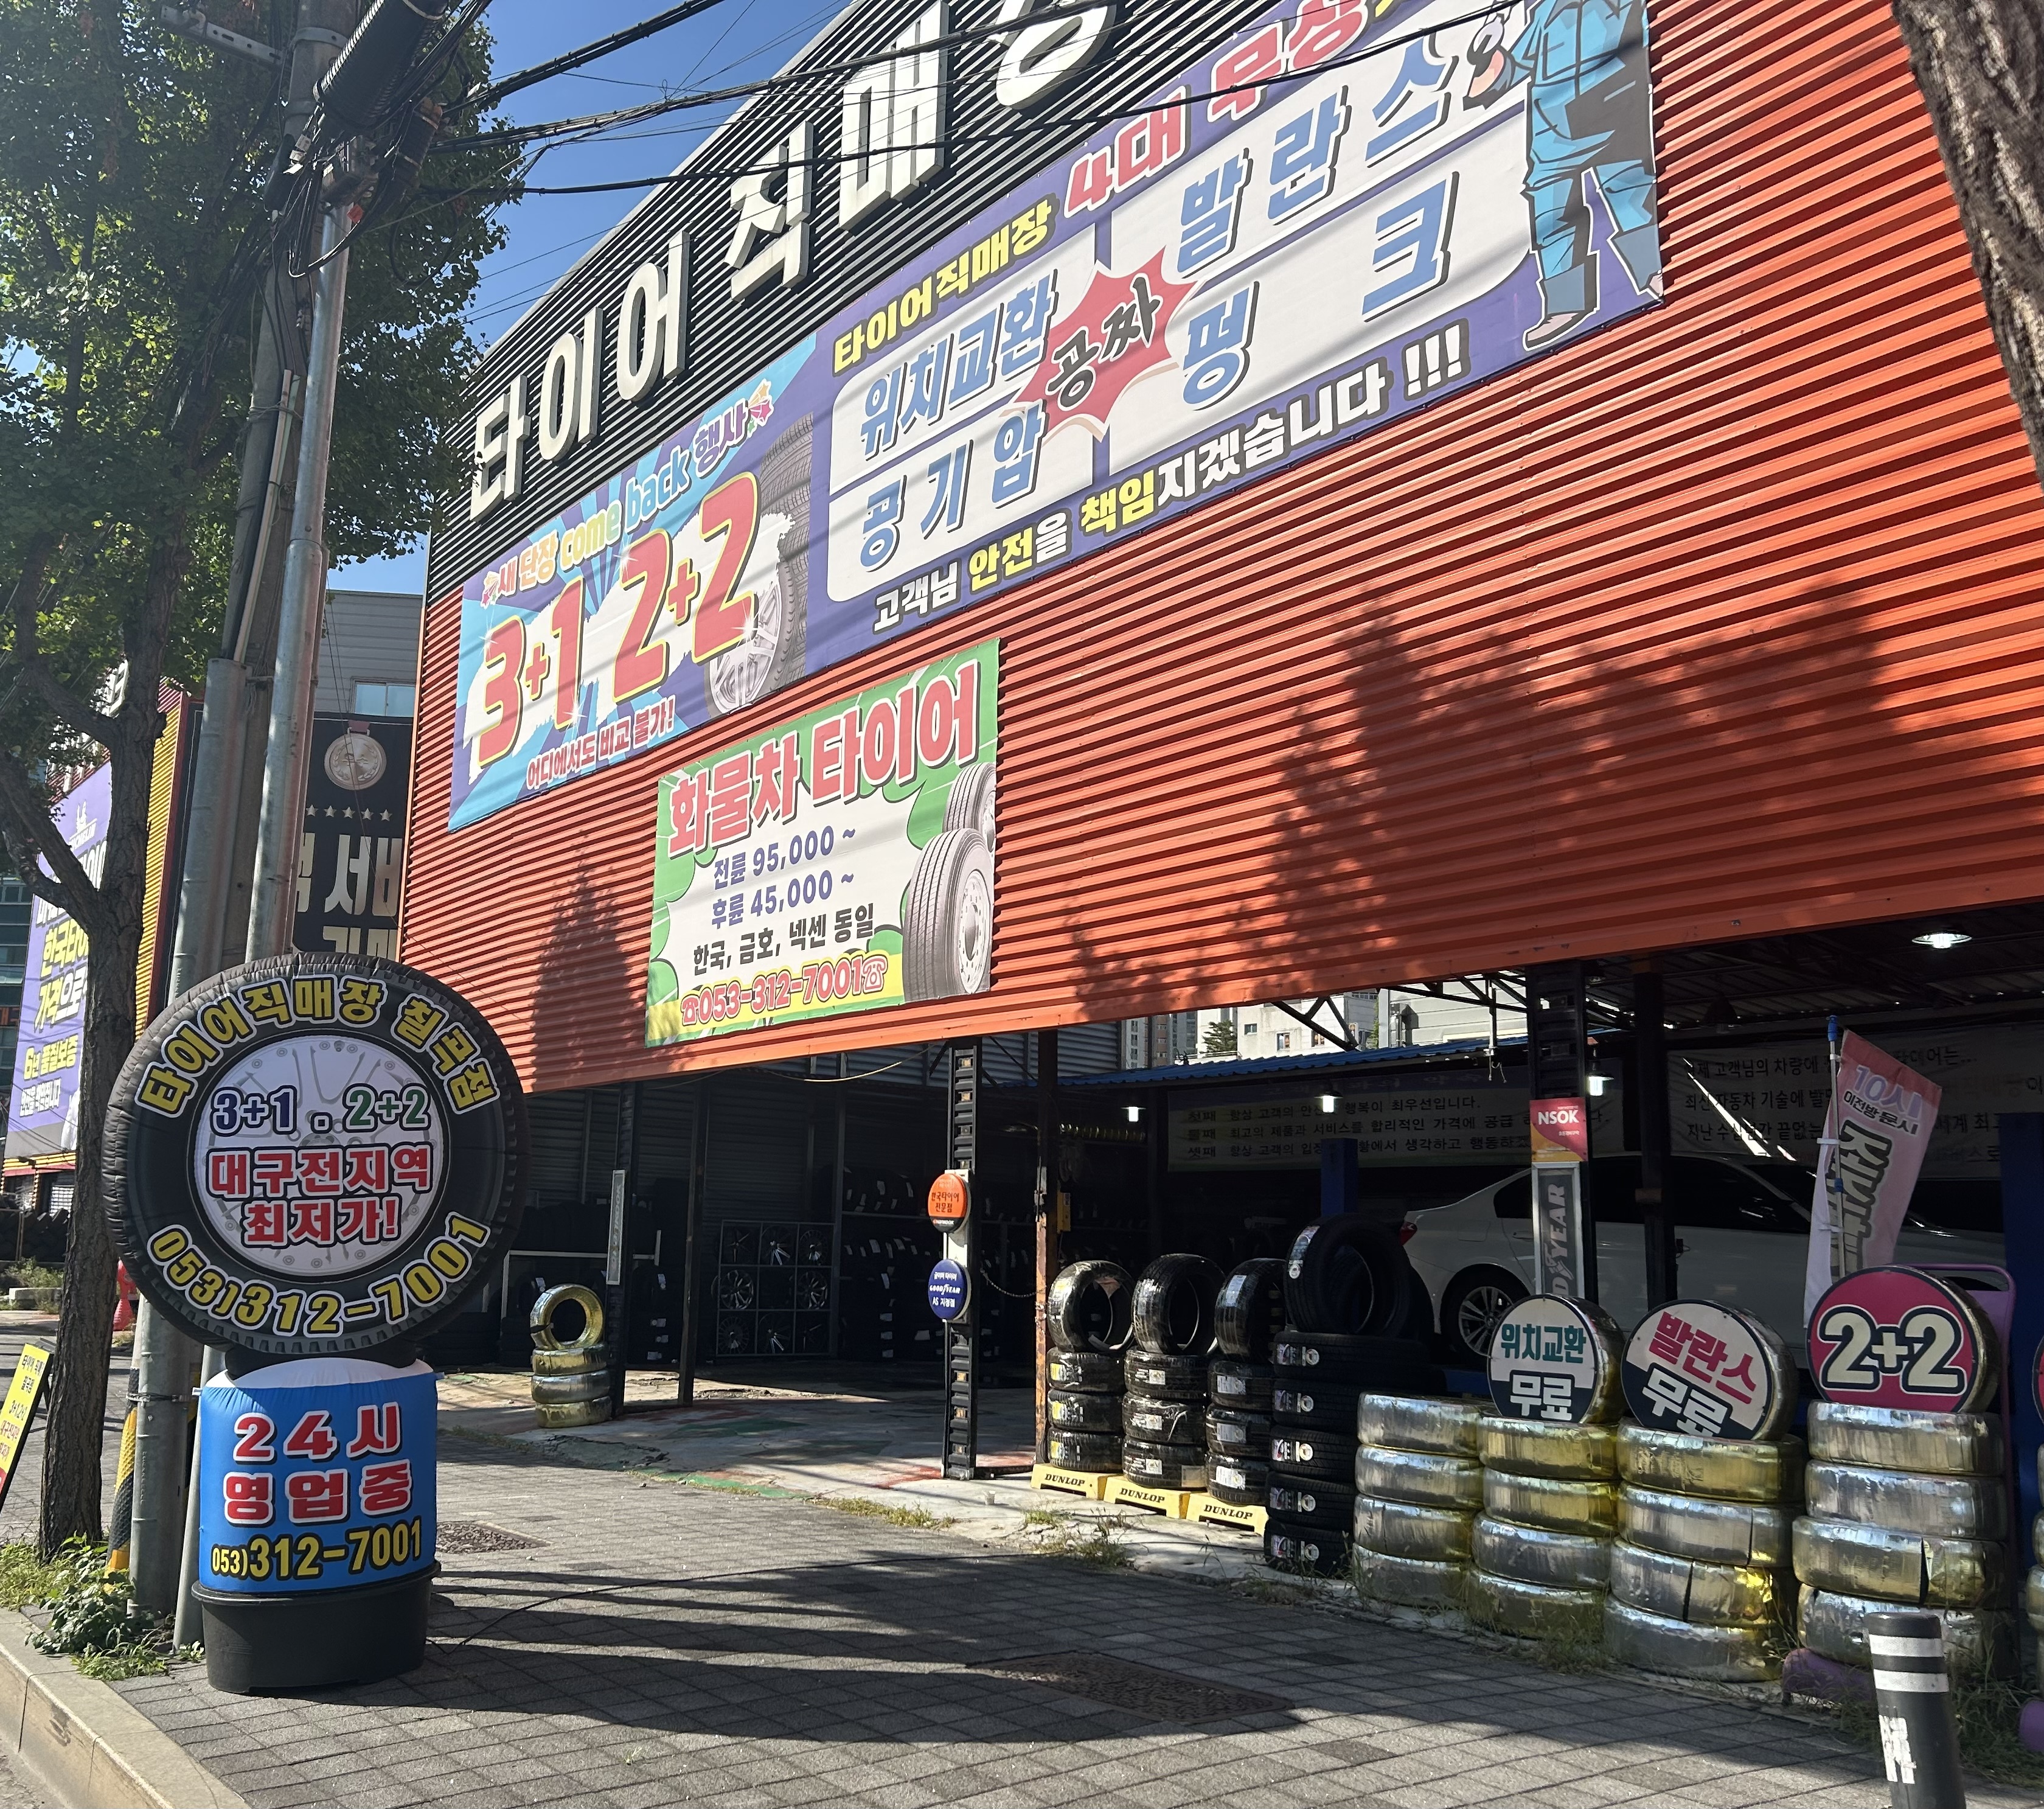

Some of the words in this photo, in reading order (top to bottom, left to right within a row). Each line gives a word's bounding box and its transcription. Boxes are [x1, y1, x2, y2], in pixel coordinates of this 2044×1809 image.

[833, 200, 1052, 372] 타이어직매장
[1065, 86, 1186, 218] 4대
[860, 273, 1058, 459] 위치교환
[1046, 274, 1161, 411] 공짜
[470, 231, 690, 521] 타이어
[519, 533, 560, 589] 단장
[560, 500, 623, 571] come
[624, 446, 691, 534] back
[693, 402, 749, 478] 행사
[874, 560, 958, 633] 고객님
[969, 512, 1068, 592] 안전을
[1080, 363, 1388, 535] 책임지겠습니다
[478, 578, 584, 767] 3+1
[612, 472, 759, 705] 2+2
[527, 731, 597, 790] 어디에서도
[599, 716, 631, 759] 비교
[632, 695, 675, 750] 불가!
[668, 730, 802, 859] 화물차
[809, 659, 980, 806] 타이어
[714, 853, 746, 890] 전륜
[753, 825, 835, 876] 95,000
[712, 893, 744, 929] 후륜
[751, 870, 833, 918] 45,000
[693, 940, 731, 976] 한국,
[739, 927, 781, 965] 금호,
[789, 916, 827, 950] 넥센
[834, 903, 875, 944] 동일
[698, 956, 863, 1025] 053-312-7001
[136, 976, 386, 1116] 타이어직매장
[392, 994, 499, 1114] 칠곡점
[1715, 1058, 1769, 1078] 고객님의
[1774, 1055, 1818, 1076] 차량에
[210, 1086, 299, 1134] 3+1
[344, 1083, 429, 1132] 2+2
[1229, 1109, 1252, 1121] 항상
[1259, 1106, 1293, 1119] 고객의
[1344, 1100, 1383, 1114] 행복이
[1391, 1096, 1481, 1111] 최우선입니다.
[1538, 1109, 1579, 1125] NSOK
[1762, 1090, 1805, 1109] 기술에
[1852, 1064, 1924, 1120] 10시
[1230, 1126, 1263, 1138] 최고의
[1271, 1124, 1306, 1137] 제품과
[1313, 1121, 1363, 1135] 서비스를
[1371, 1118, 1425, 1132] 합리적인
[1434, 1115, 1475, 1130] 가격에
[1230, 1145, 1252, 1157] 항상
[1259, 1143, 1294, 1155] 고객의
[1358, 1139, 1397, 1153] 황에서
[1405, 1138, 1461, 1152] 생각하고
[208, 1144, 433, 1197] 대구전지역
[243, 1196, 401, 1246] 최저가!
[932, 1296, 939, 1306] AS
[1501, 1323, 1586, 1364] 위치교환
[1647, 1311, 1758, 1405] 발란스
[1820, 1305, 1967, 1396] 2+2
[1509, 1374, 1573, 1421] 무료
[1642, 1366, 1732, 1438] 무료
[233, 1401, 403, 1462] 24시
[223, 1459, 412, 1525] 영업중
[1044, 1473, 1085, 1487] DUNLOP
[1119, 1487, 1165, 1504] DUNLOP
[1203, 1504, 1253, 1521] DUNLOP
[211, 1518, 422, 1578] 053)312-7001
